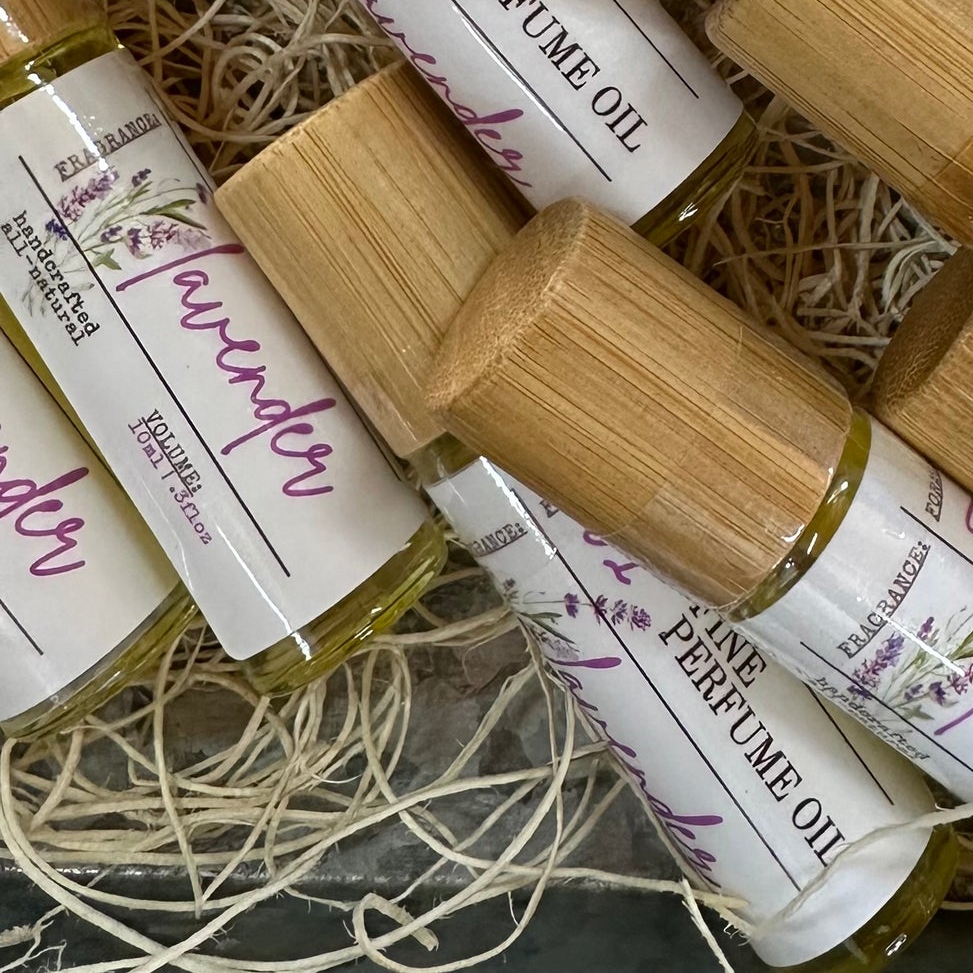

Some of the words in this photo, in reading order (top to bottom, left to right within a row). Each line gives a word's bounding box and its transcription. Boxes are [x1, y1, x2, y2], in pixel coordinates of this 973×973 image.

[591, 83, 648, 155] OIL
[0, 224, 85, 347] all-natural
[12, 209, 101, 338] handcrafted
[116, 244, 337, 498] lavender
[128, 423, 163, 470] 10ml
[139, 409, 203, 498] VOLUME:
[837, 540, 930, 660] FRAGRANCE:
[659, 619, 802, 802] PERFUME
[791, 797, 849, 866] OIL
